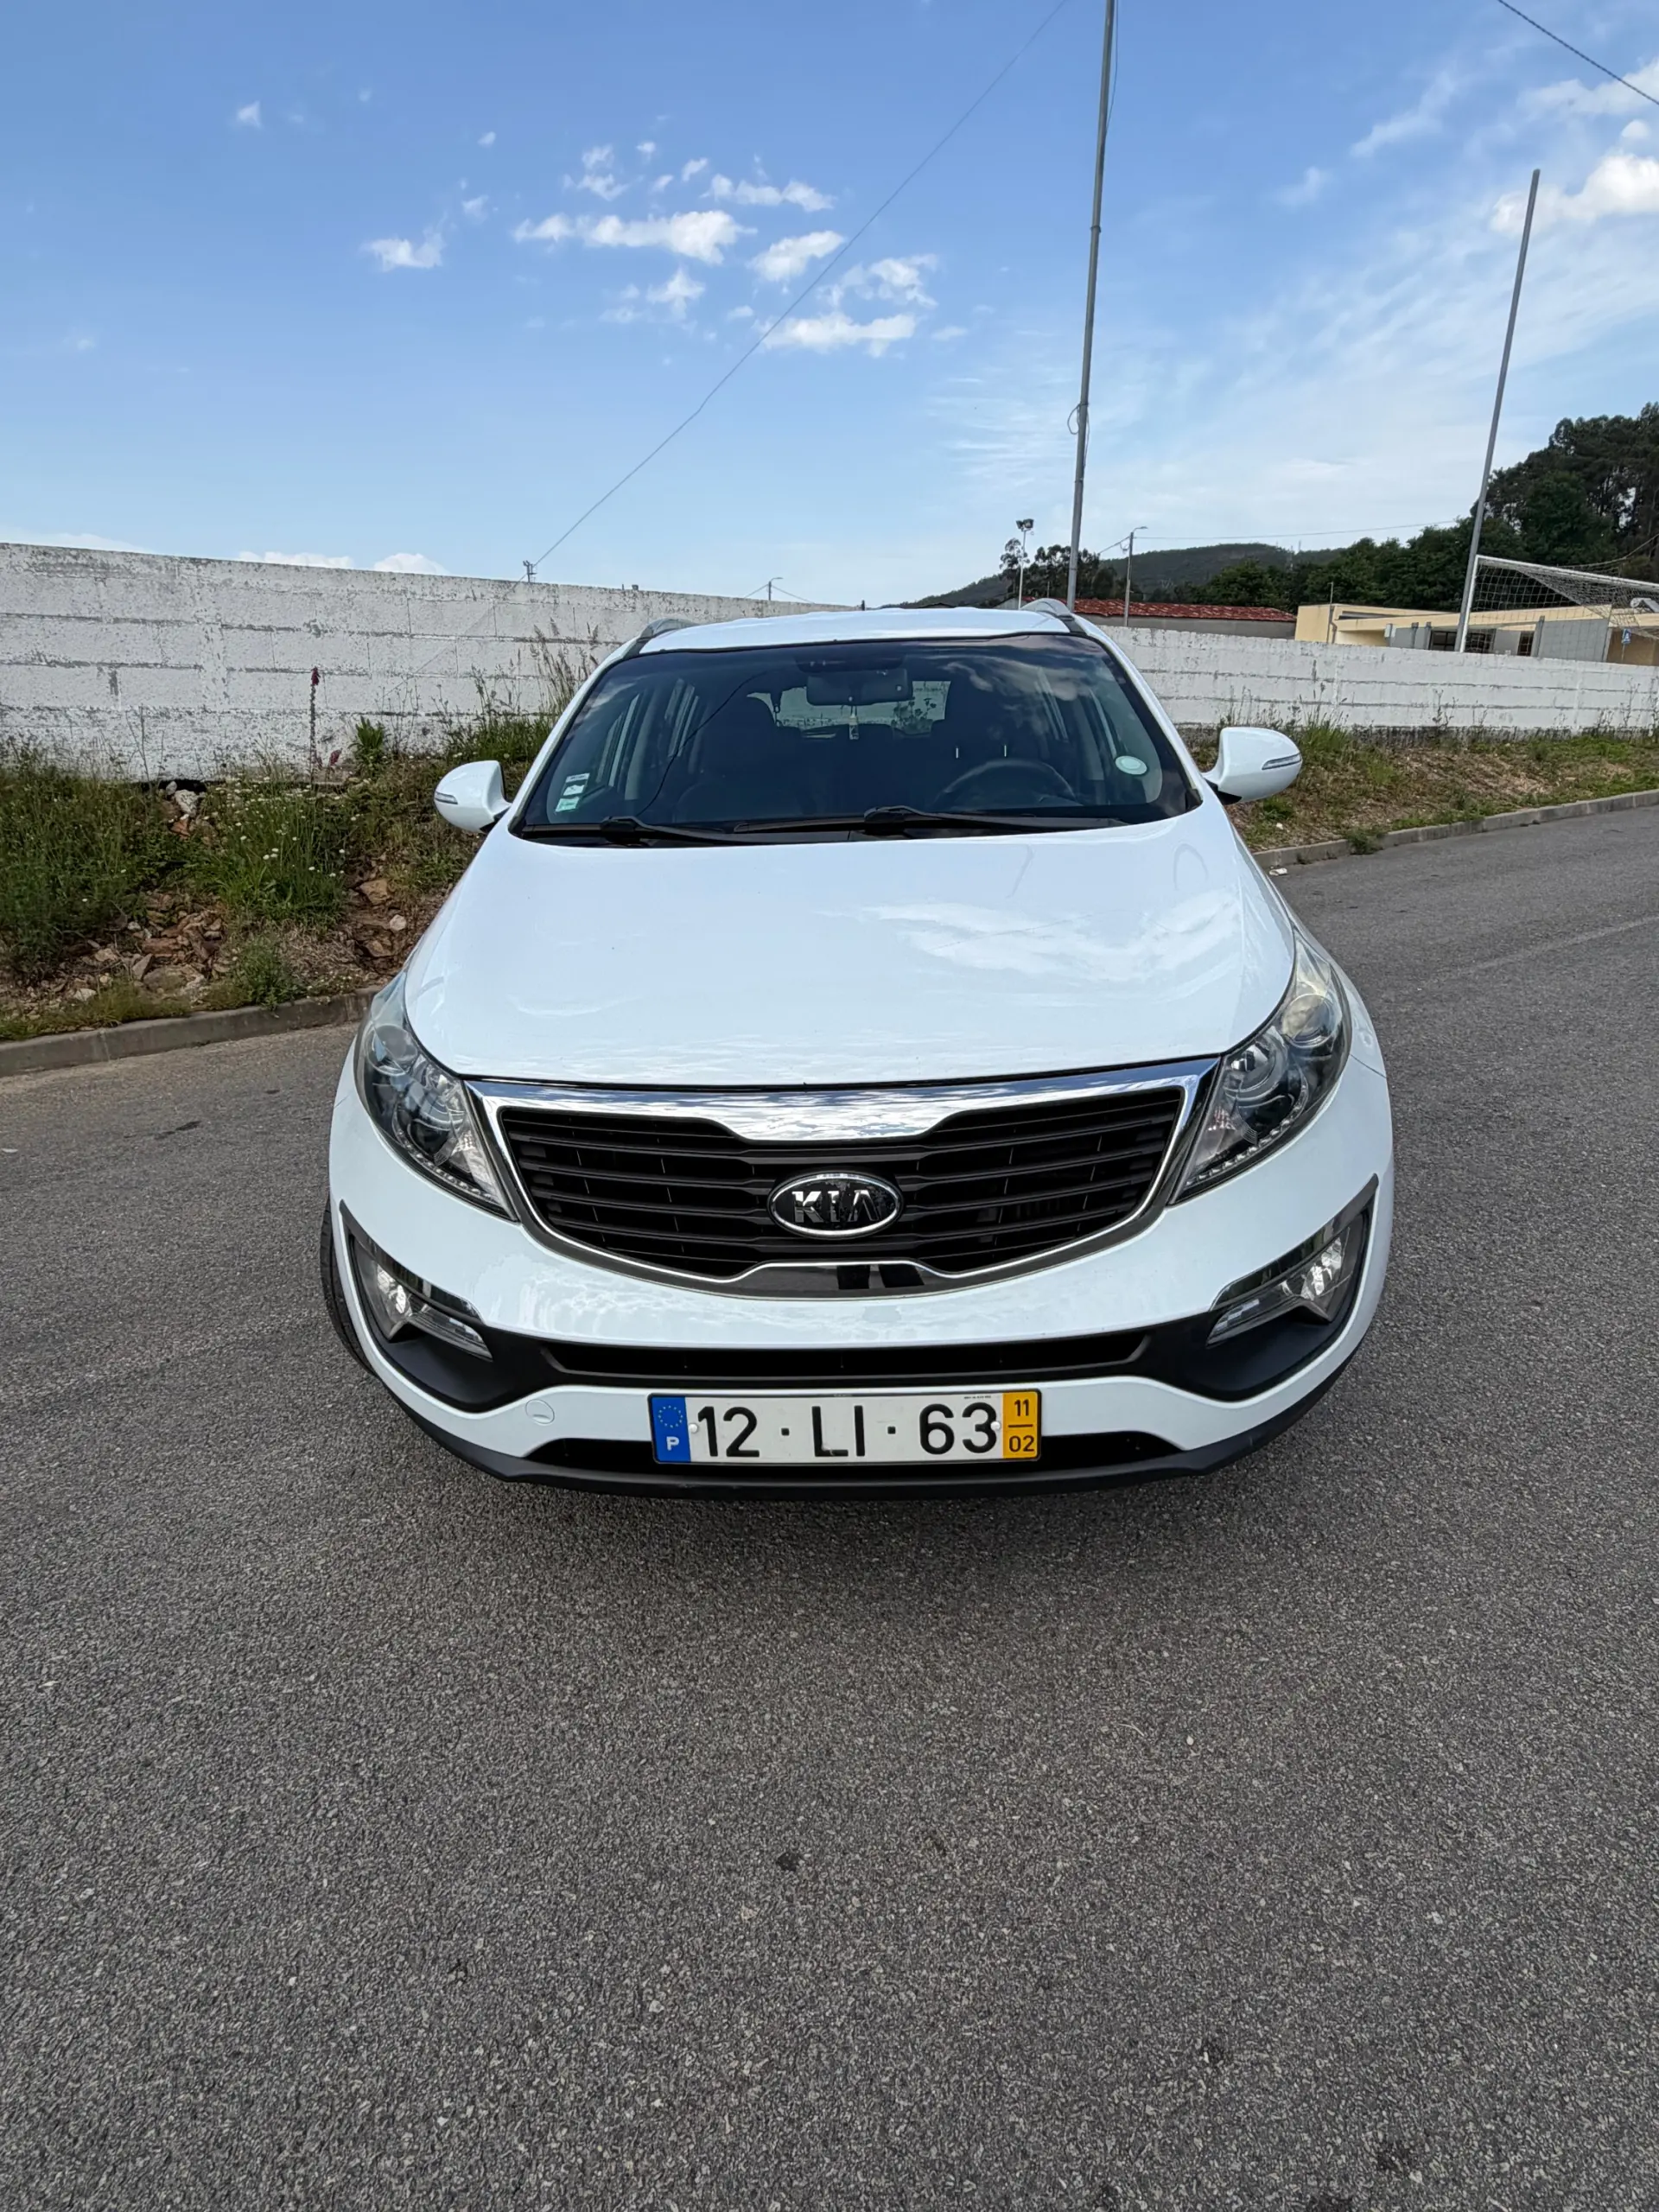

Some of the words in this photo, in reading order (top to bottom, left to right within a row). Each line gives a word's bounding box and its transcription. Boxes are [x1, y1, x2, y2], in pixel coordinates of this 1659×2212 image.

[791, 1189, 880, 1224] KIA
[1014, 1398, 1030, 1417] 11
[697, 1406, 760, 1458] 12
[918, 1402, 997, 1455] 63
[666, 1435, 680, 1452] P
[1008, 1434, 1035, 1453] 02
